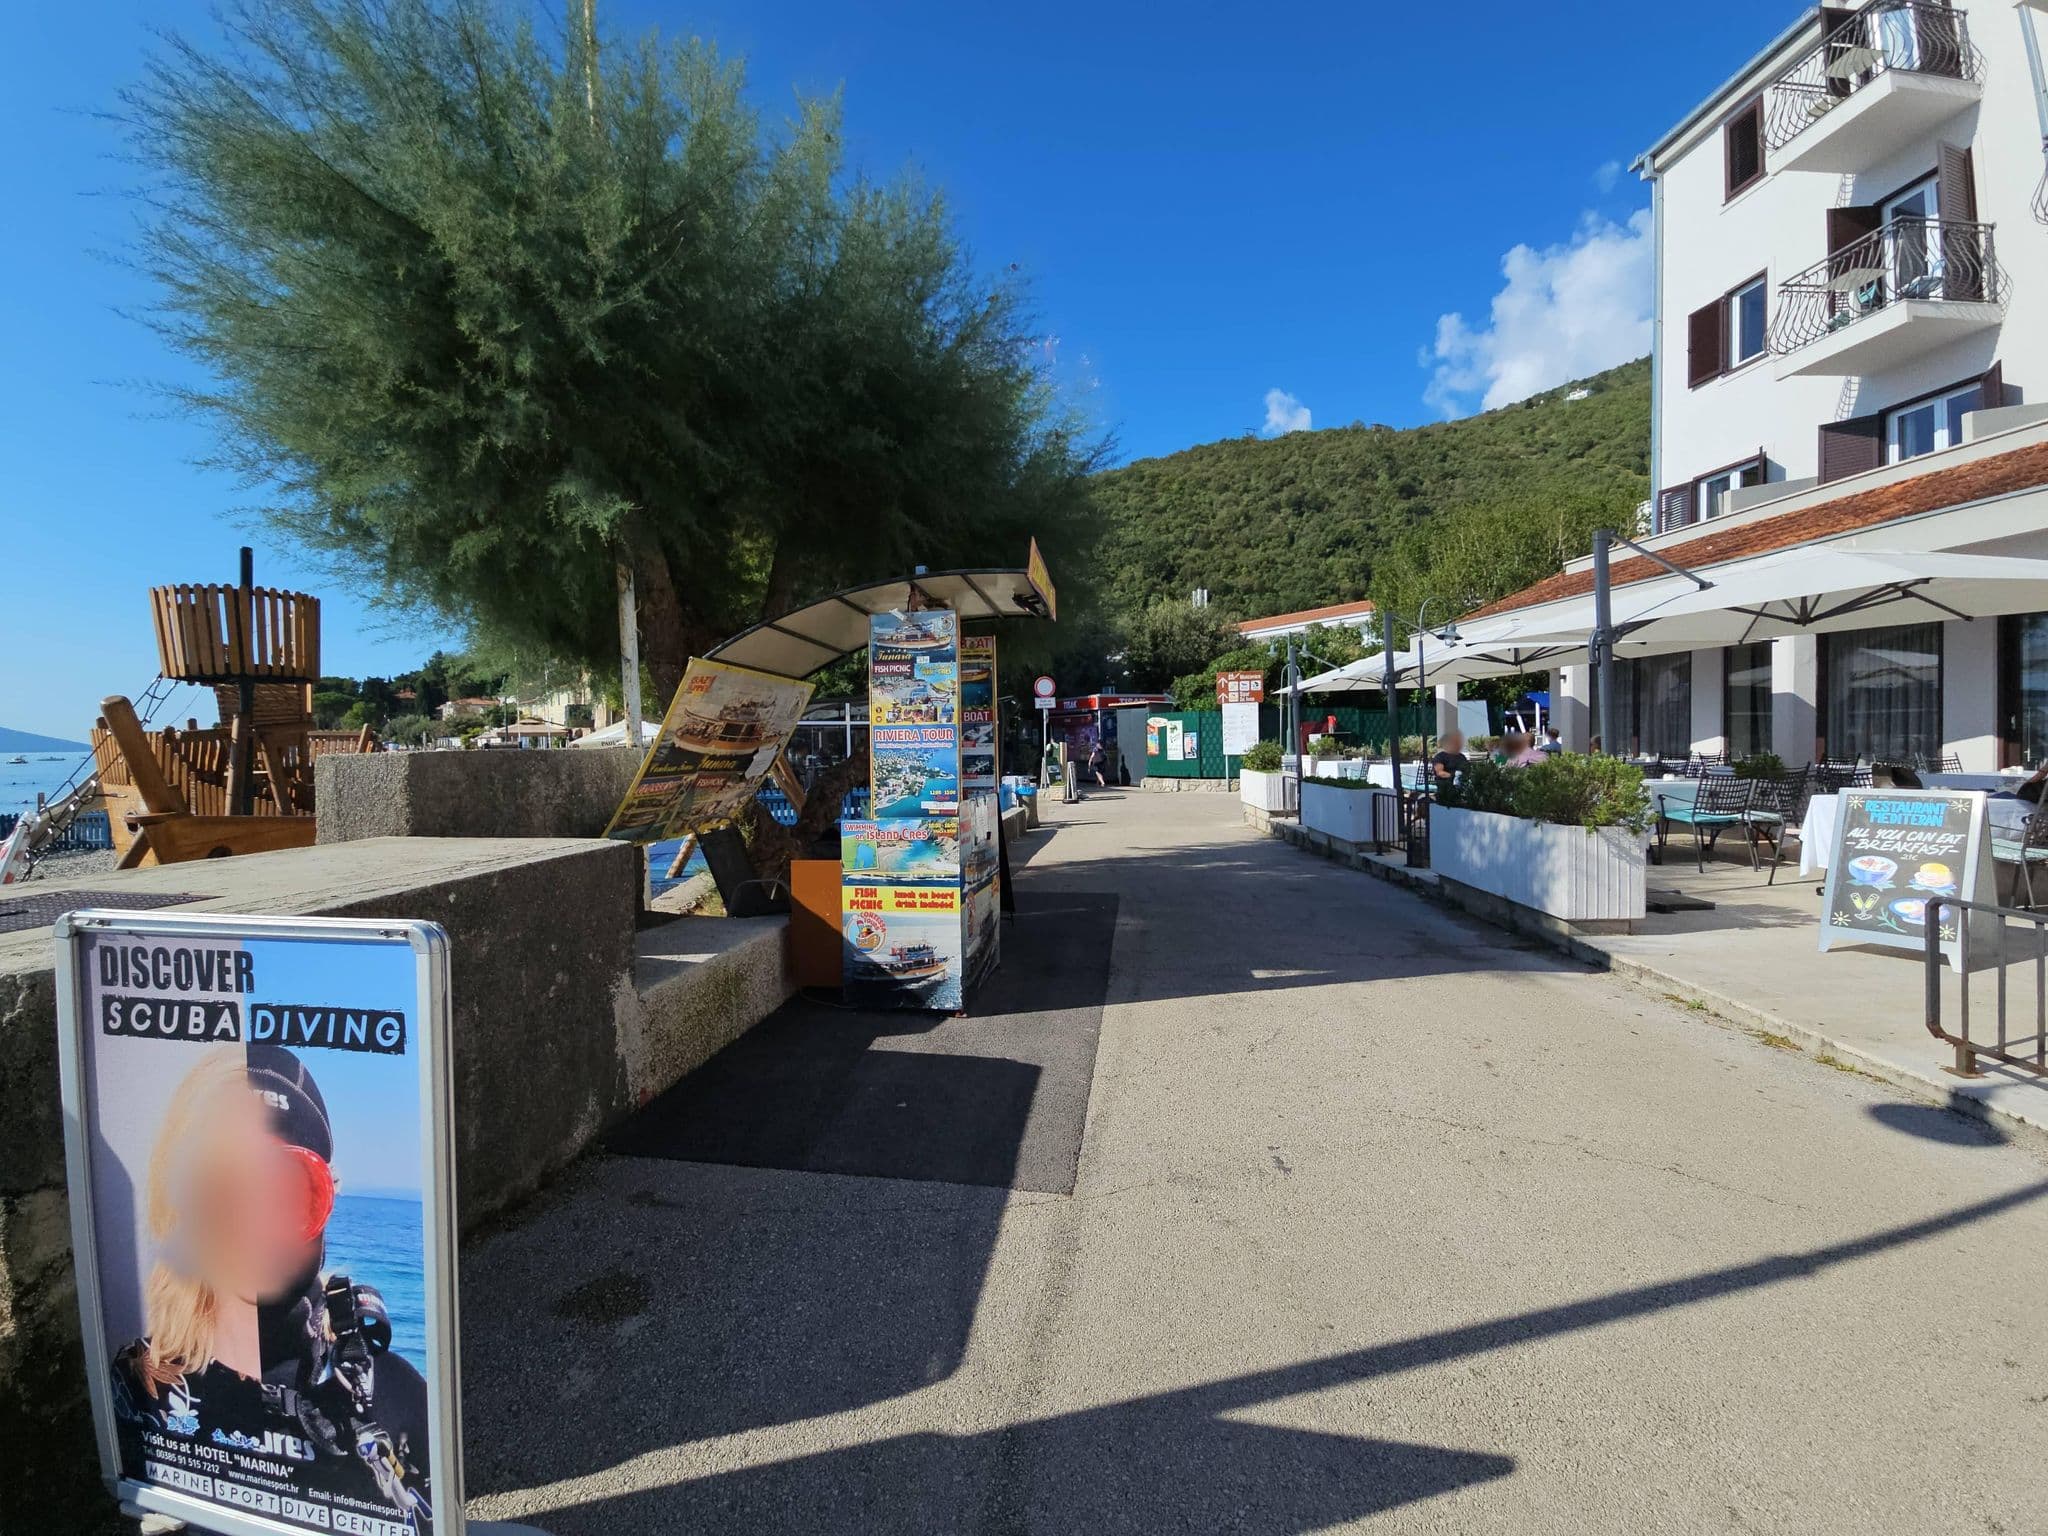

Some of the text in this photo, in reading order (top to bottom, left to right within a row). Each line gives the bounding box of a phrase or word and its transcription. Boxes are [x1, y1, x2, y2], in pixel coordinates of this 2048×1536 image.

[874, 664, 911, 673] FISH PICNIC
[963, 711, 990, 721] BOAT
[874, 728, 954, 742] RIVIERA TOUR
[1865, 799, 1947, 815] RESTAURANT
[1869, 812, 1943, 827] MEDITERAN
[1847, 827, 1966, 845] ALL YOU CAN EAT
[854, 887, 877, 898] FISH
[931, 891, 955, 900] board
[849, 899, 883, 910] PICNIC
[895, 900, 917, 908] drink
[100, 945, 255, 993] DISCOVER
[107, 1001, 401, 1047] SCUBA DIVING
[141, 1430, 165, 1447] Visit
[166, 1438, 178, 1451] us
[179, 1442, 191, 1454] at
[194, 1443, 233, 1465] HOTEL
[177, 1454, 187, 1466] 91
[188, 1457, 201, 1470] 515
[202, 1461, 220, 1474] 7212
[228, 1469, 299, 1494] www.marinesport.hr
[308, 1487, 332, 1502] Email:
[148, 1463, 410, 1536] MARINE SPORT DIVE CENTER
